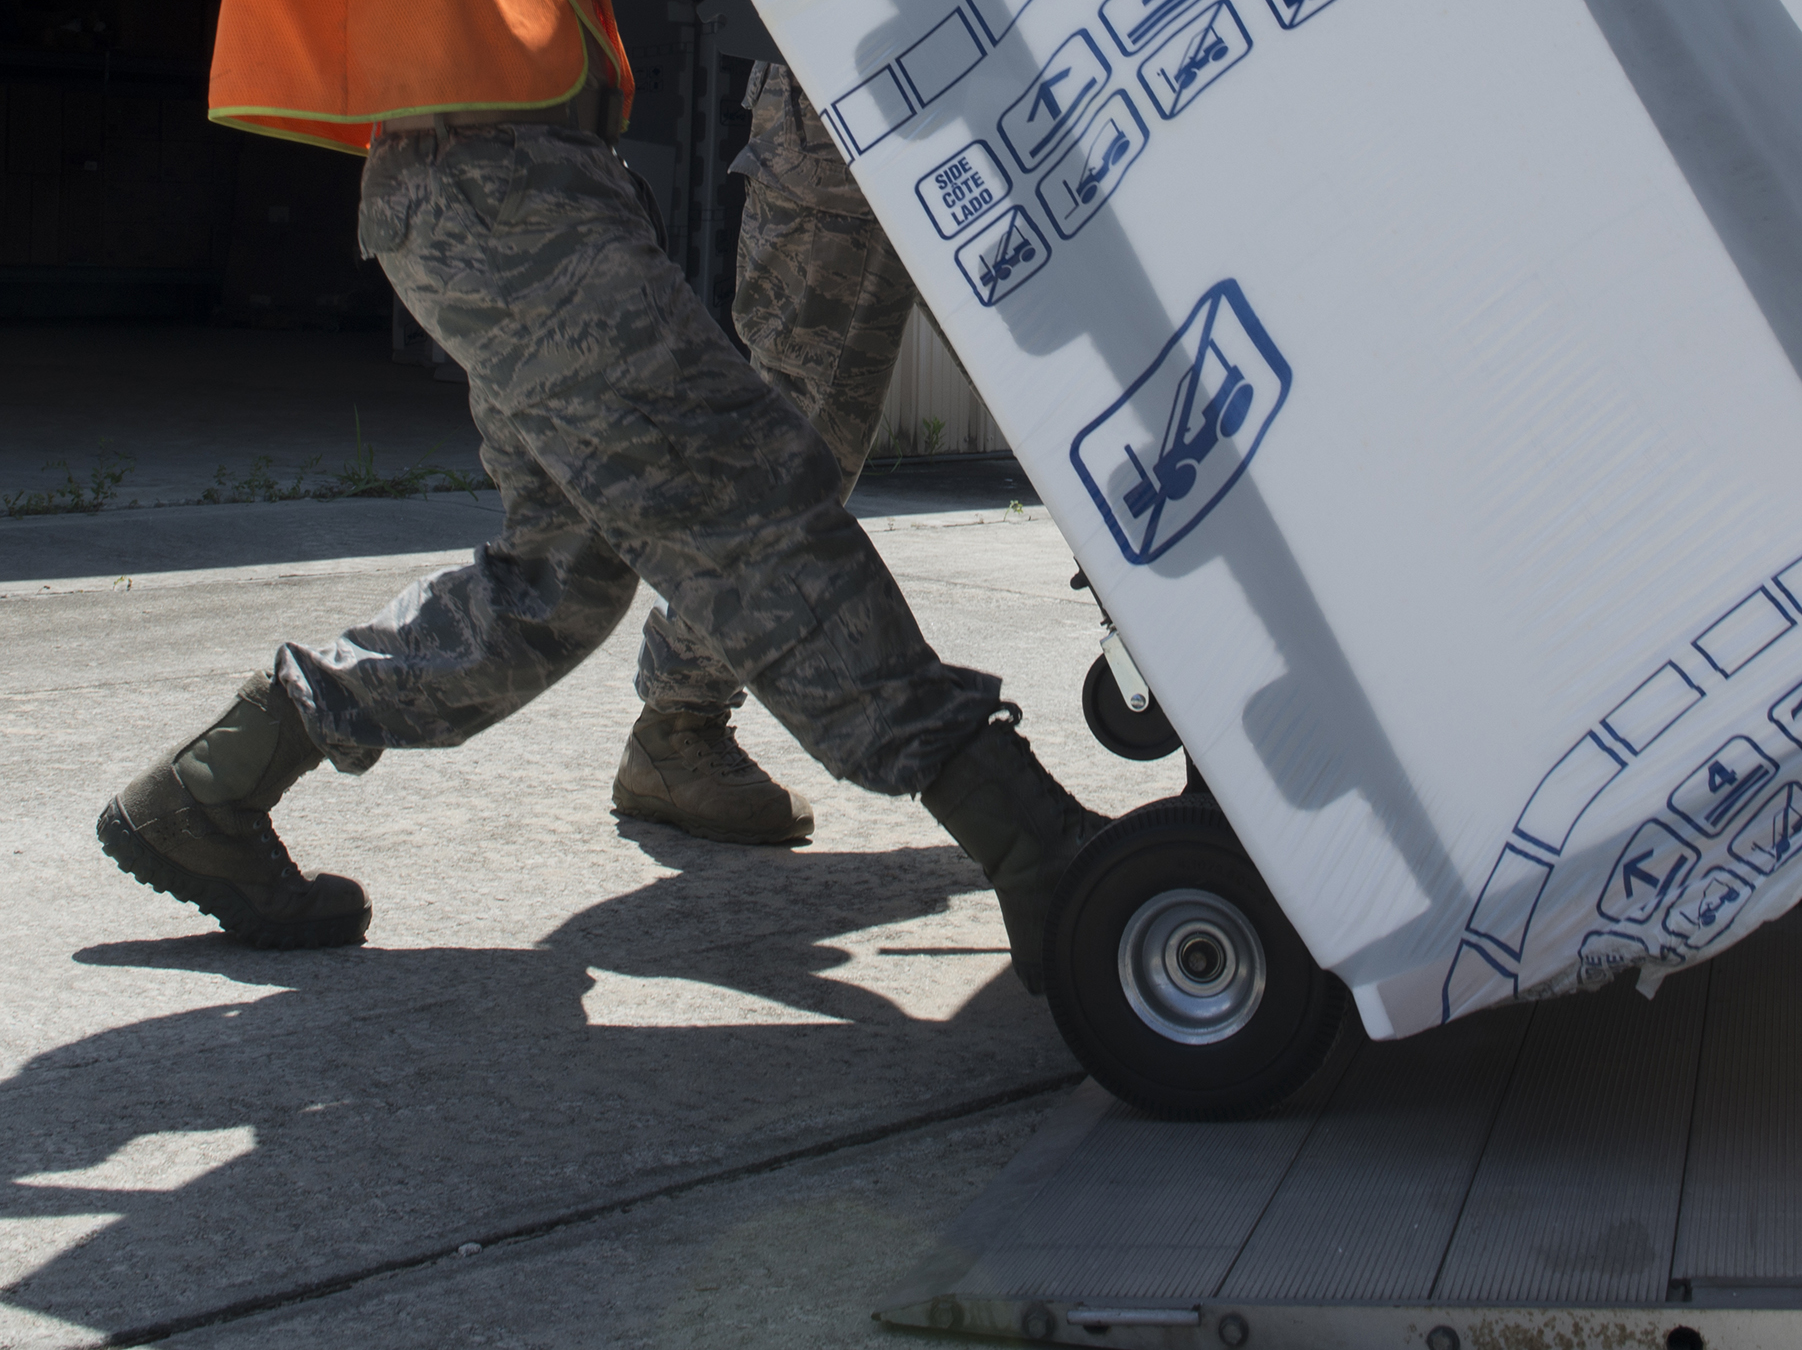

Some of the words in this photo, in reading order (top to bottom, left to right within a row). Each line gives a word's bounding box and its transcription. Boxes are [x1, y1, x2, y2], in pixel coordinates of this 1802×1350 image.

[934, 156, 973, 191] SIDE
[942, 171, 985, 209] CÔTE
[950, 188, 994, 227] LADO
[1707, 759, 1738, 795] 4
